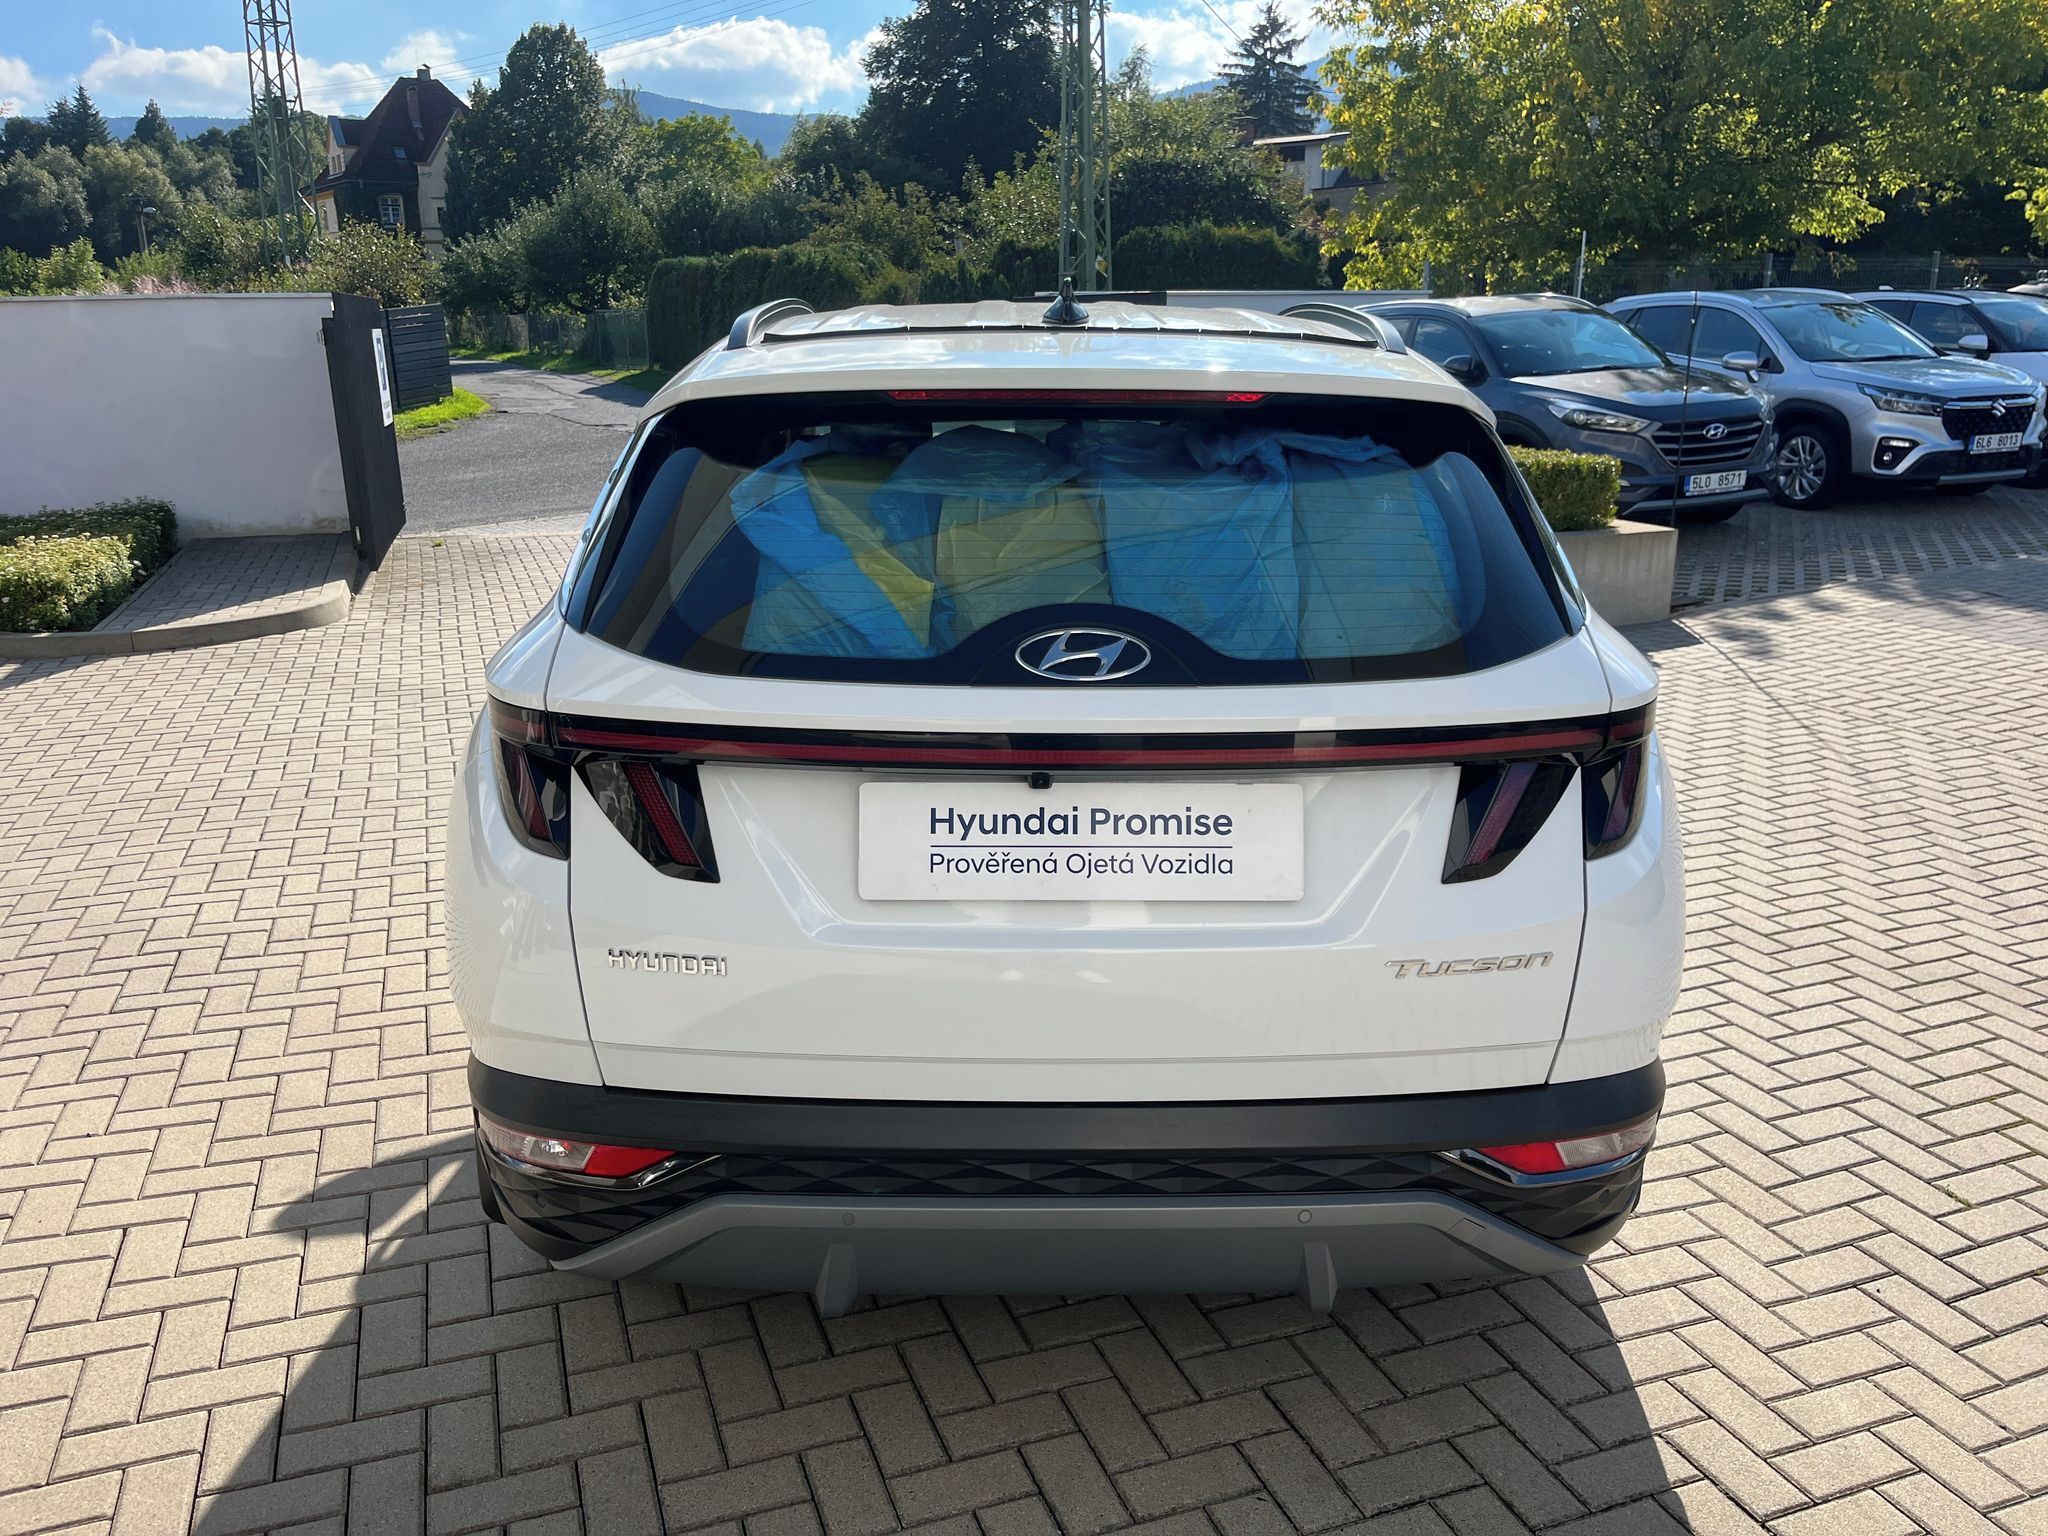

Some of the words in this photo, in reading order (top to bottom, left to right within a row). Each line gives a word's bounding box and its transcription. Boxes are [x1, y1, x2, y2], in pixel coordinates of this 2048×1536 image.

[1975, 436, 1992, 448] 6L6
[1718, 472, 1742, 487] 8571
[930, 806, 1079, 841] Hyundai
[1090, 806, 1233, 837] Promise
[929, 852, 1058, 875] Prověřená
[1066, 852, 1134, 879] Ojetá
[1141, 853, 1234, 875] Vozidla
[608, 948, 727, 977] HYUNDAI
